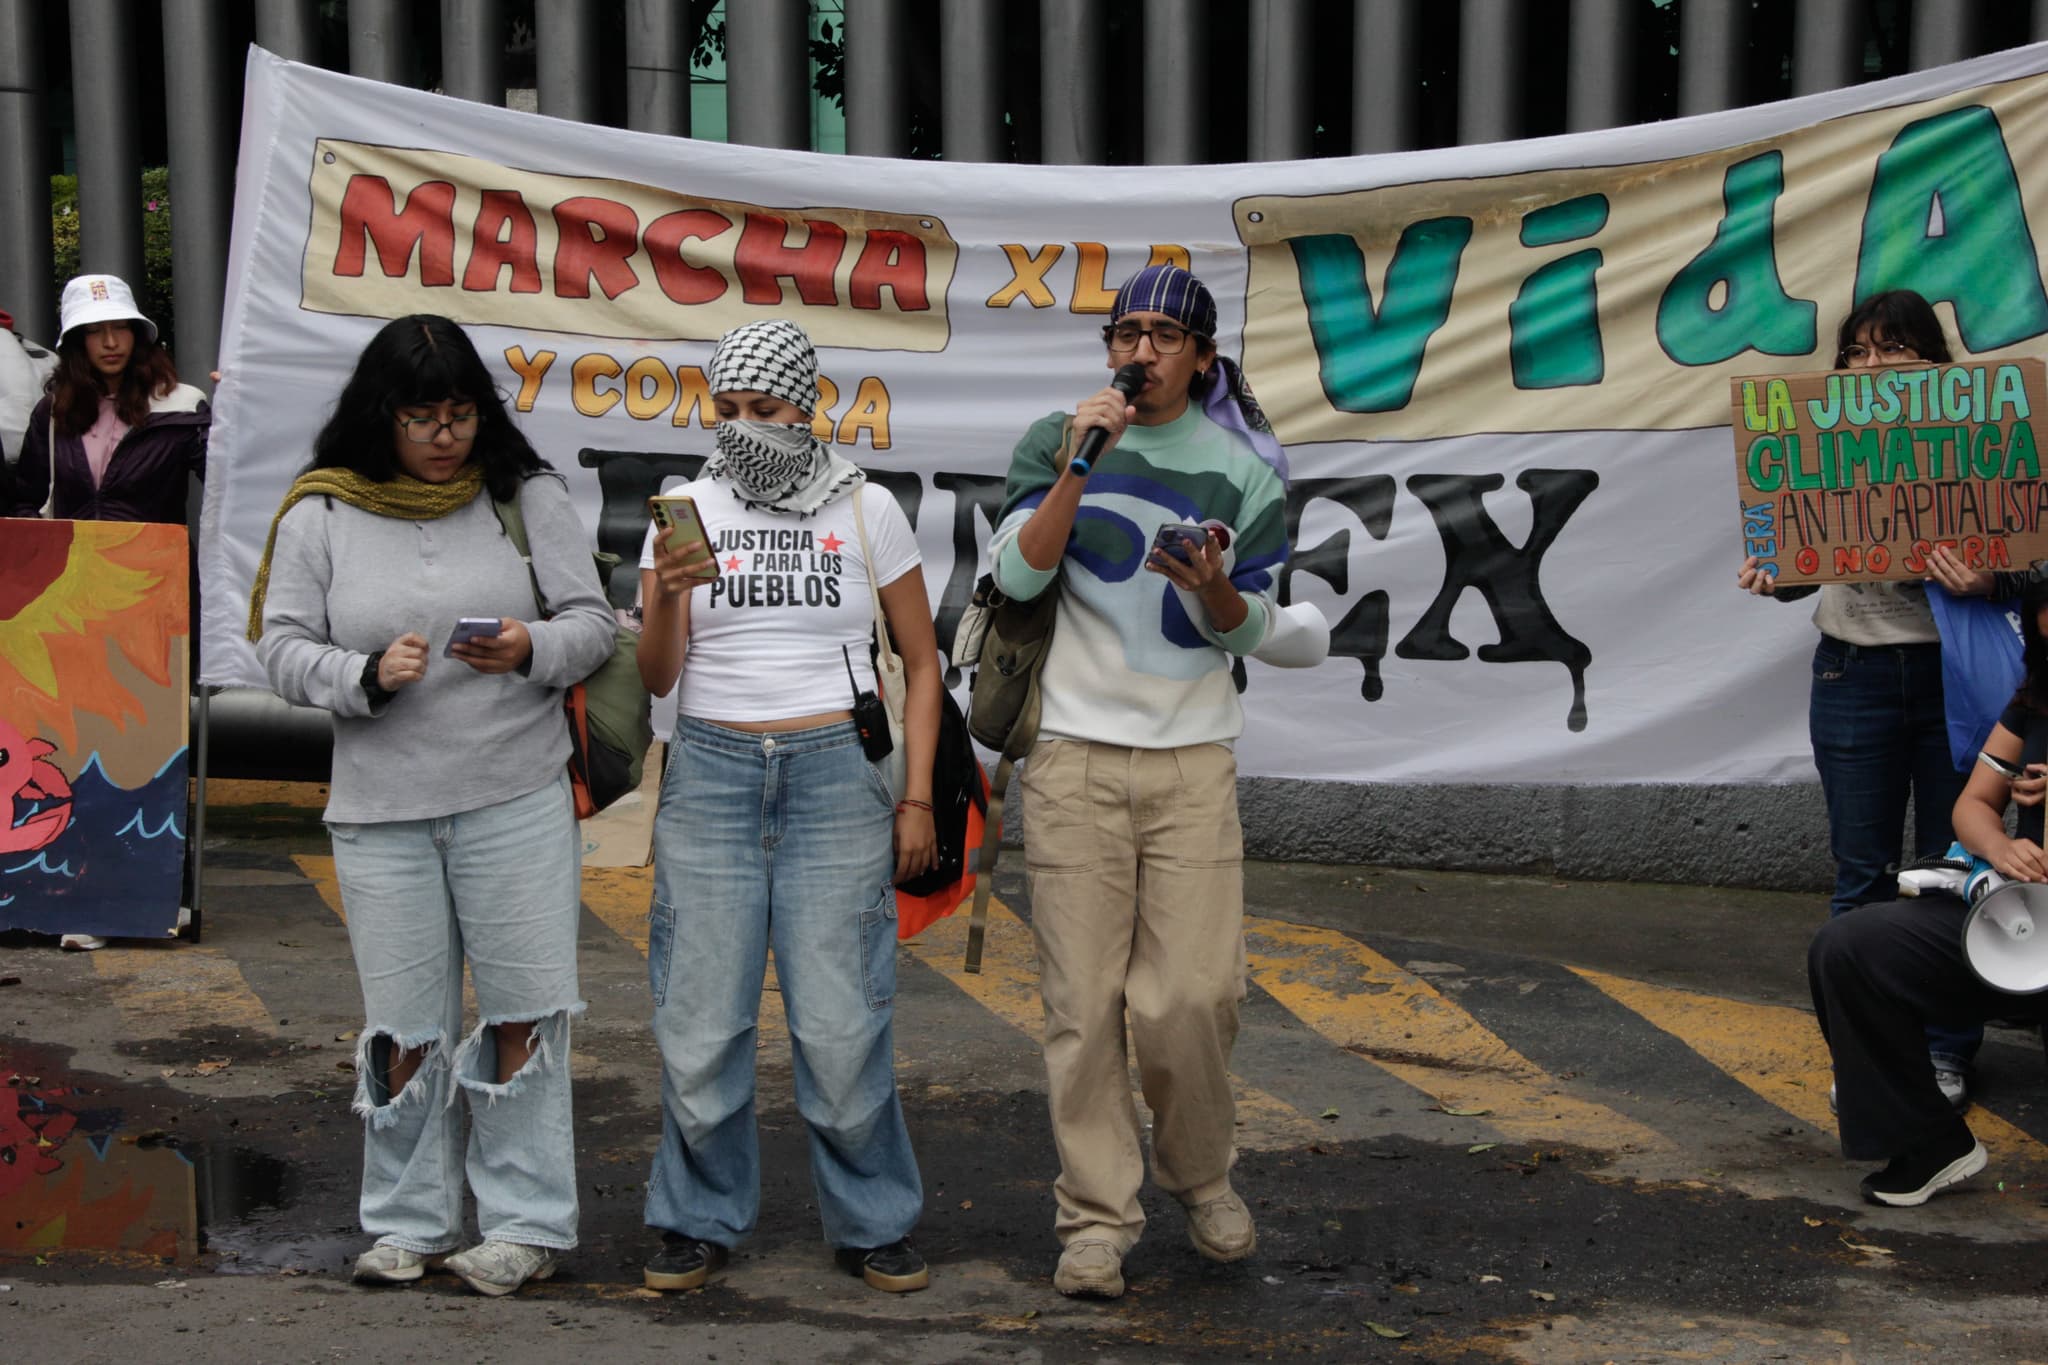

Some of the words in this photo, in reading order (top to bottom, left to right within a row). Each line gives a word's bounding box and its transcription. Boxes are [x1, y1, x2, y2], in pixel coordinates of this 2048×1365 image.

[332, 173, 930, 311] MARCHA
[504, 345, 557, 412] Y
[570, 352, 891, 450] CONRA
[1741, 378, 1797, 433] LA
[1807, 363, 2031, 430] JUSTICIA
[1746, 415, 2041, 492] CLIMÁTICA
[712, 529, 814, 552] JUSTICIA
[752, 552, 803, 573] PARA
[810, 552, 843, 576] LOS
[1795, 546, 1820, 576] O
[1833, 544, 1891, 576] NO
[710, 574, 842, 609] PUEBLOS
